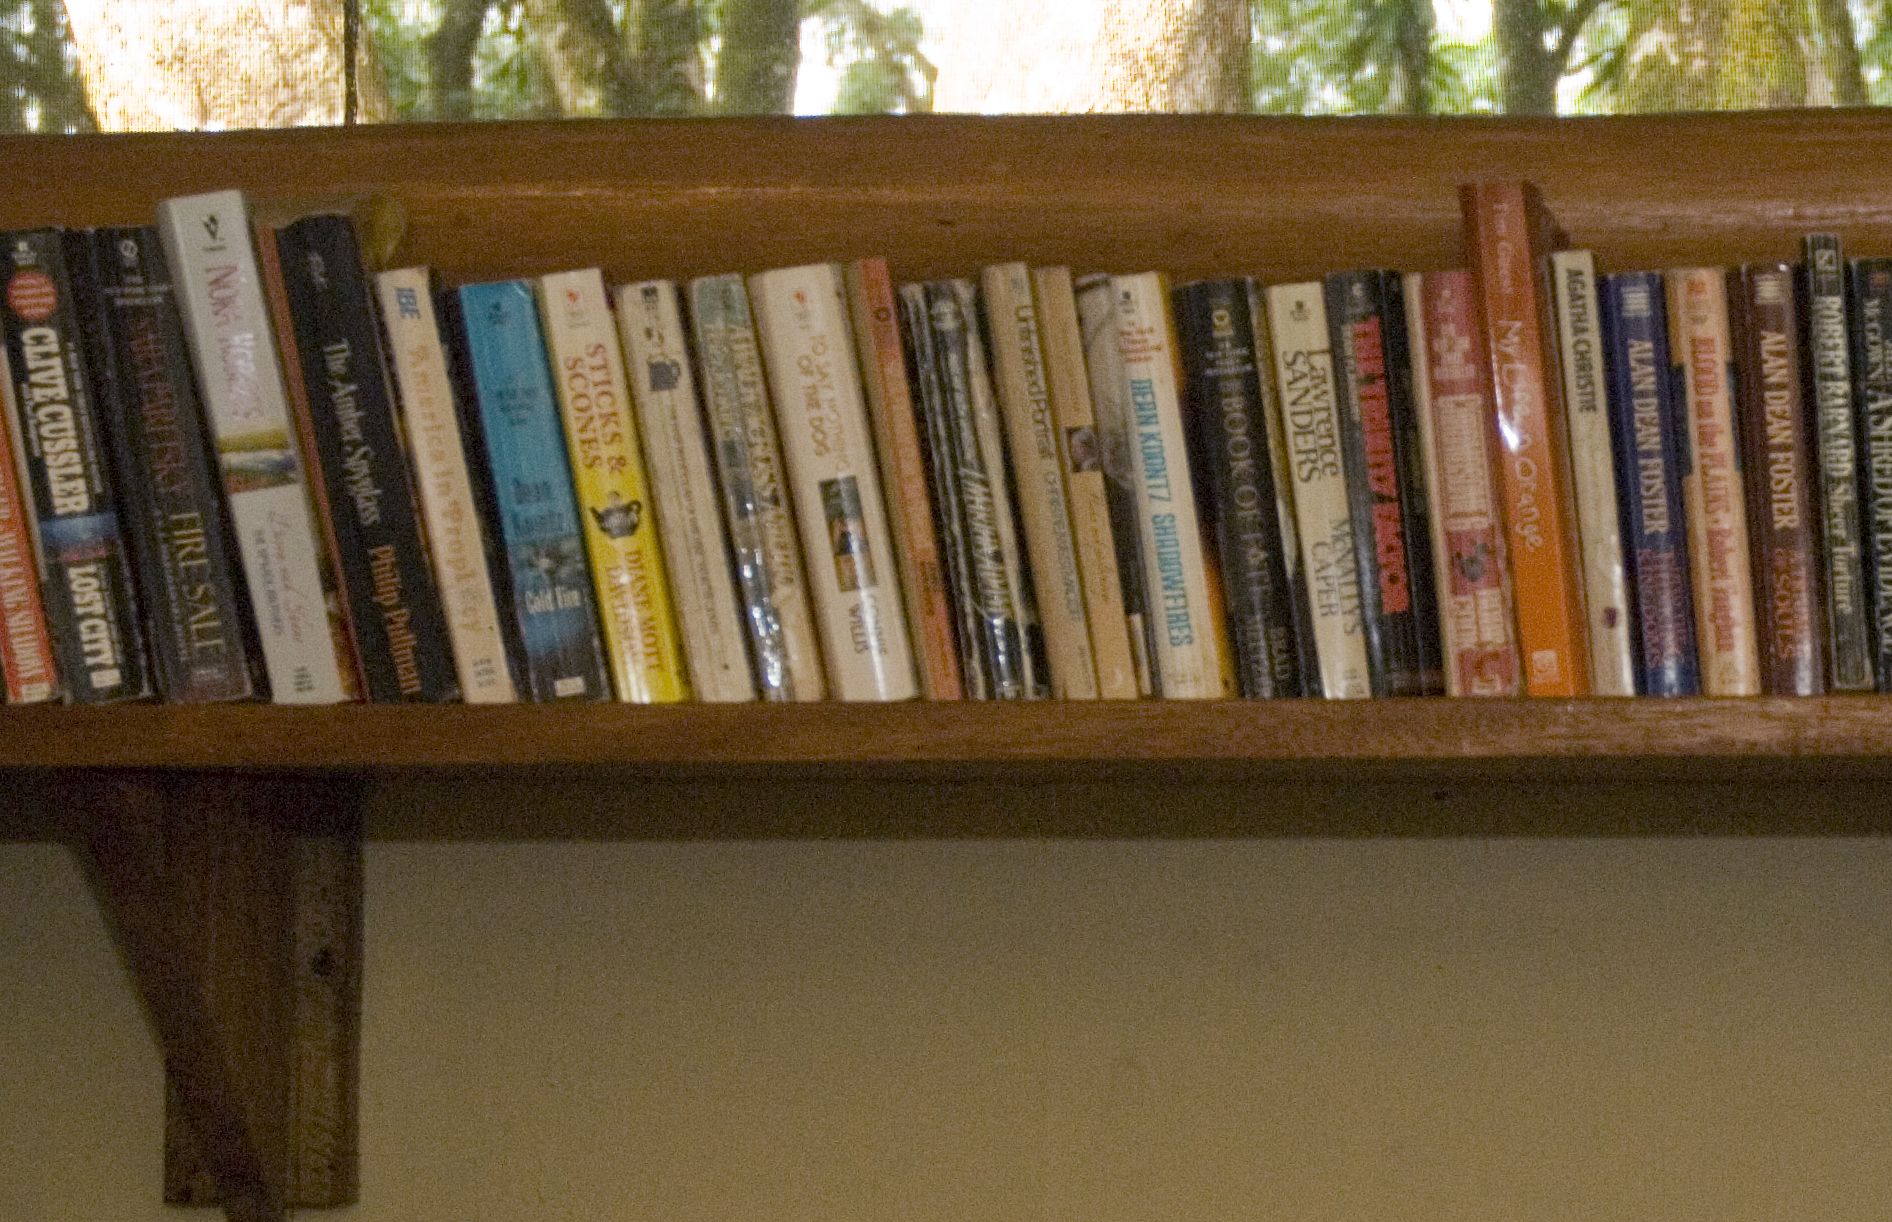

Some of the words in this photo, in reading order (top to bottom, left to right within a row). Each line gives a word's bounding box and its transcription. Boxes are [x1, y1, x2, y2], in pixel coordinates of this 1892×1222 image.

[1565, 269, 1587, 336] AGATHA
[1813, 295, 1847, 377] ROBERT
[21, 327, 62, 403] CLIVE
[324, 339, 352, 376] The
[1013, 304, 1052, 398] Unfinished
[1571, 339, 1597, 414] CHRISTIE
[1627, 339, 1657, 392] ALAN
[1760, 330, 1792, 384] ALAN
[332, 379, 365, 442] Amber
[563, 356, 601, 471] SCONES
[585, 342, 624, 446] STICKS
[605, 454, 627, 476] &
[1026, 398, 1057, 461] Portrait
[1130, 379, 1158, 427] DEAN
[1282, 350, 1322, 485] SANDERS
[1305, 348, 1341, 478] Lawrence
[1633, 397, 1664, 452] DEAN
[1763, 389, 1794, 446] DEAN
[1821, 380, 1854, 478] BARNARD
[41, 404, 90, 515] CUSSLER
[343, 444, 383, 526] Spyglass
[1138, 432, 1171, 504] KOONTZ
[1769, 451, 1800, 530] FOSTER
[1637, 458, 1672, 536] FOSTER
[1828, 482, 1853, 539] Sheer
[67, 564, 105, 615] LOST
[367, 545, 400, 604] Philip
[1150, 513, 1194, 647] SHADOWFIRES
[1833, 541, 1859, 614] Torture
[80, 618, 114, 669] CITY
[380, 609, 422, 695] Pullman
